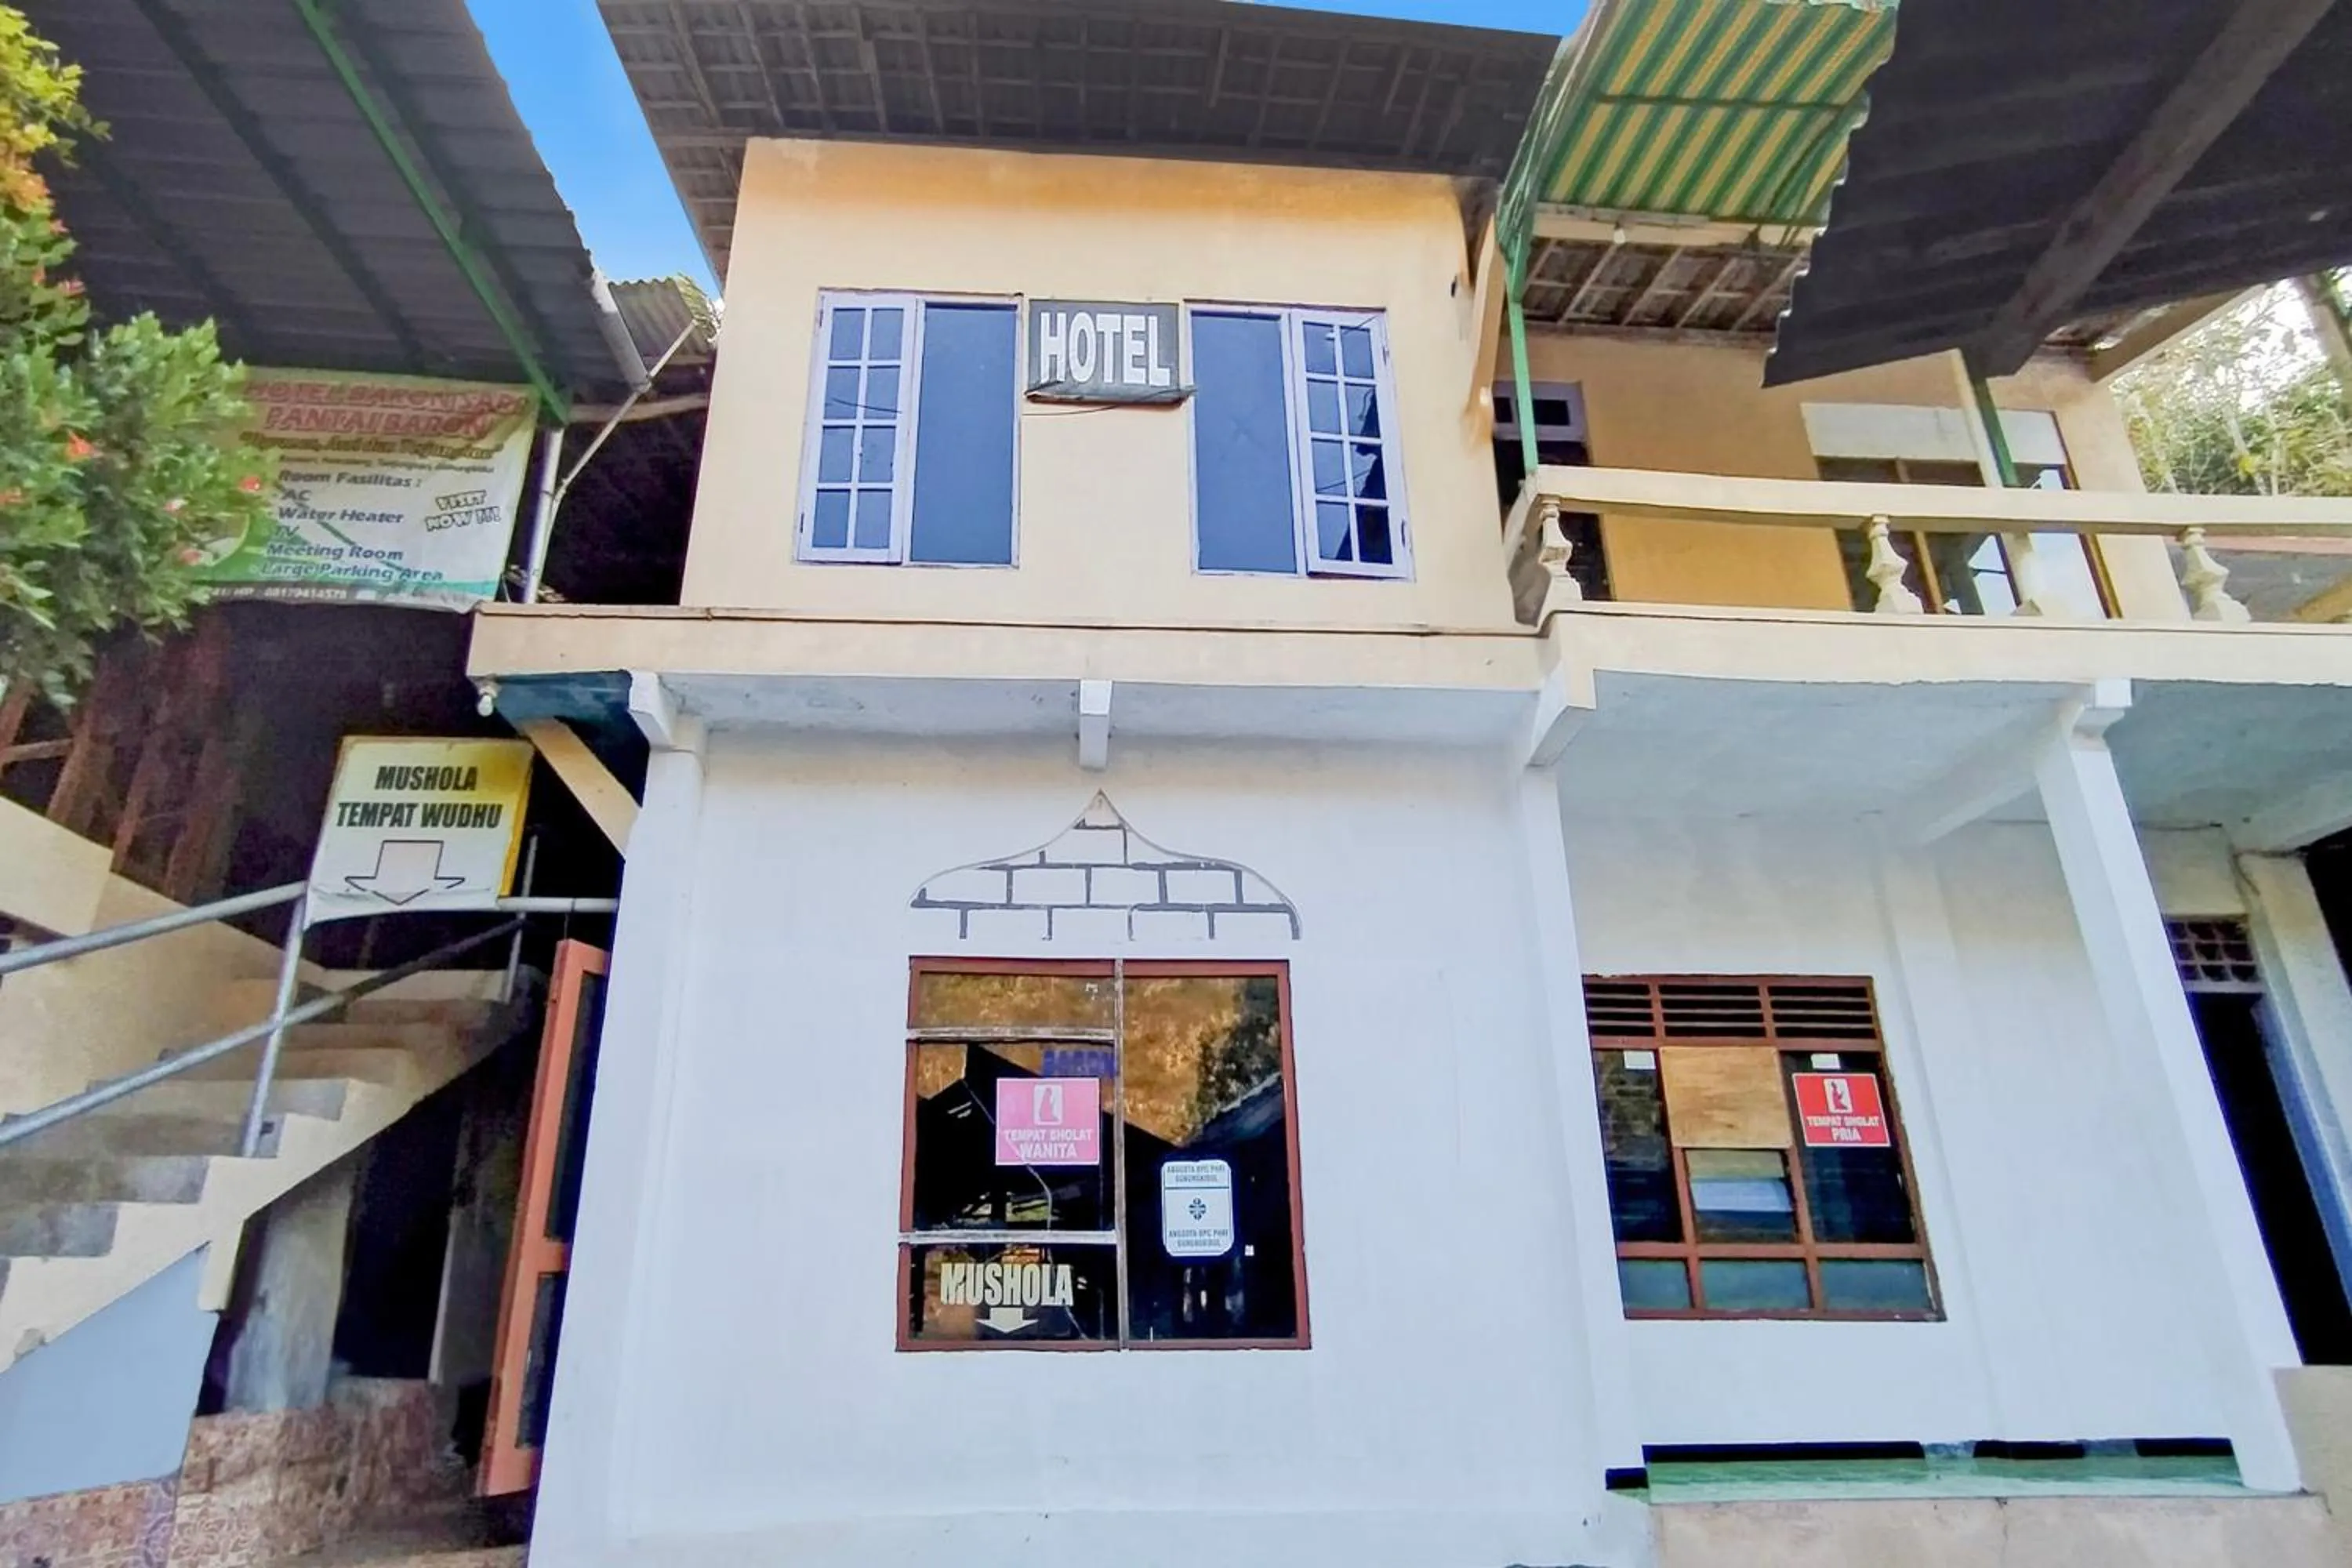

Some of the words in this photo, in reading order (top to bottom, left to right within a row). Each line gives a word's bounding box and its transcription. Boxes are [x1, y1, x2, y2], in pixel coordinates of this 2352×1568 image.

[1040, 312, 1171, 387] HOTEL
[264, 407, 378, 433] PANTAI
[278, 470, 331, 484] Room
[336, 472, 412, 488] Fasilitas
[281, 489, 312, 502] AC
[278, 507, 336, 521] Water
[339, 510, 405, 524] Heater
[425, 510, 473, 532] NOW
[274, 525, 299, 537] TV
[266, 544, 345, 561] Meeting
[349, 546, 405, 561] Room
[261, 560, 315, 576] Large
[318, 562, 395, 583] Parking
[398, 567, 445, 583] Area
[374, 765, 478, 792] MUSHOLA
[336, 801, 419, 829] TEMPAT
[419, 802, 504, 829] WUDHU
[1806, 1115, 1842, 1127] TEMPAT
[1843, 1115, 1879, 1127] SHOLAT
[1004, 1128, 1046, 1142] TEMPAT
[1049, 1128, 1092, 1142] SHOLAT
[1831, 1127, 1863, 1142] PRIA
[1019, 1142, 1078, 1160] WANITA
[940, 1262, 1074, 1308] MUSHOLA
